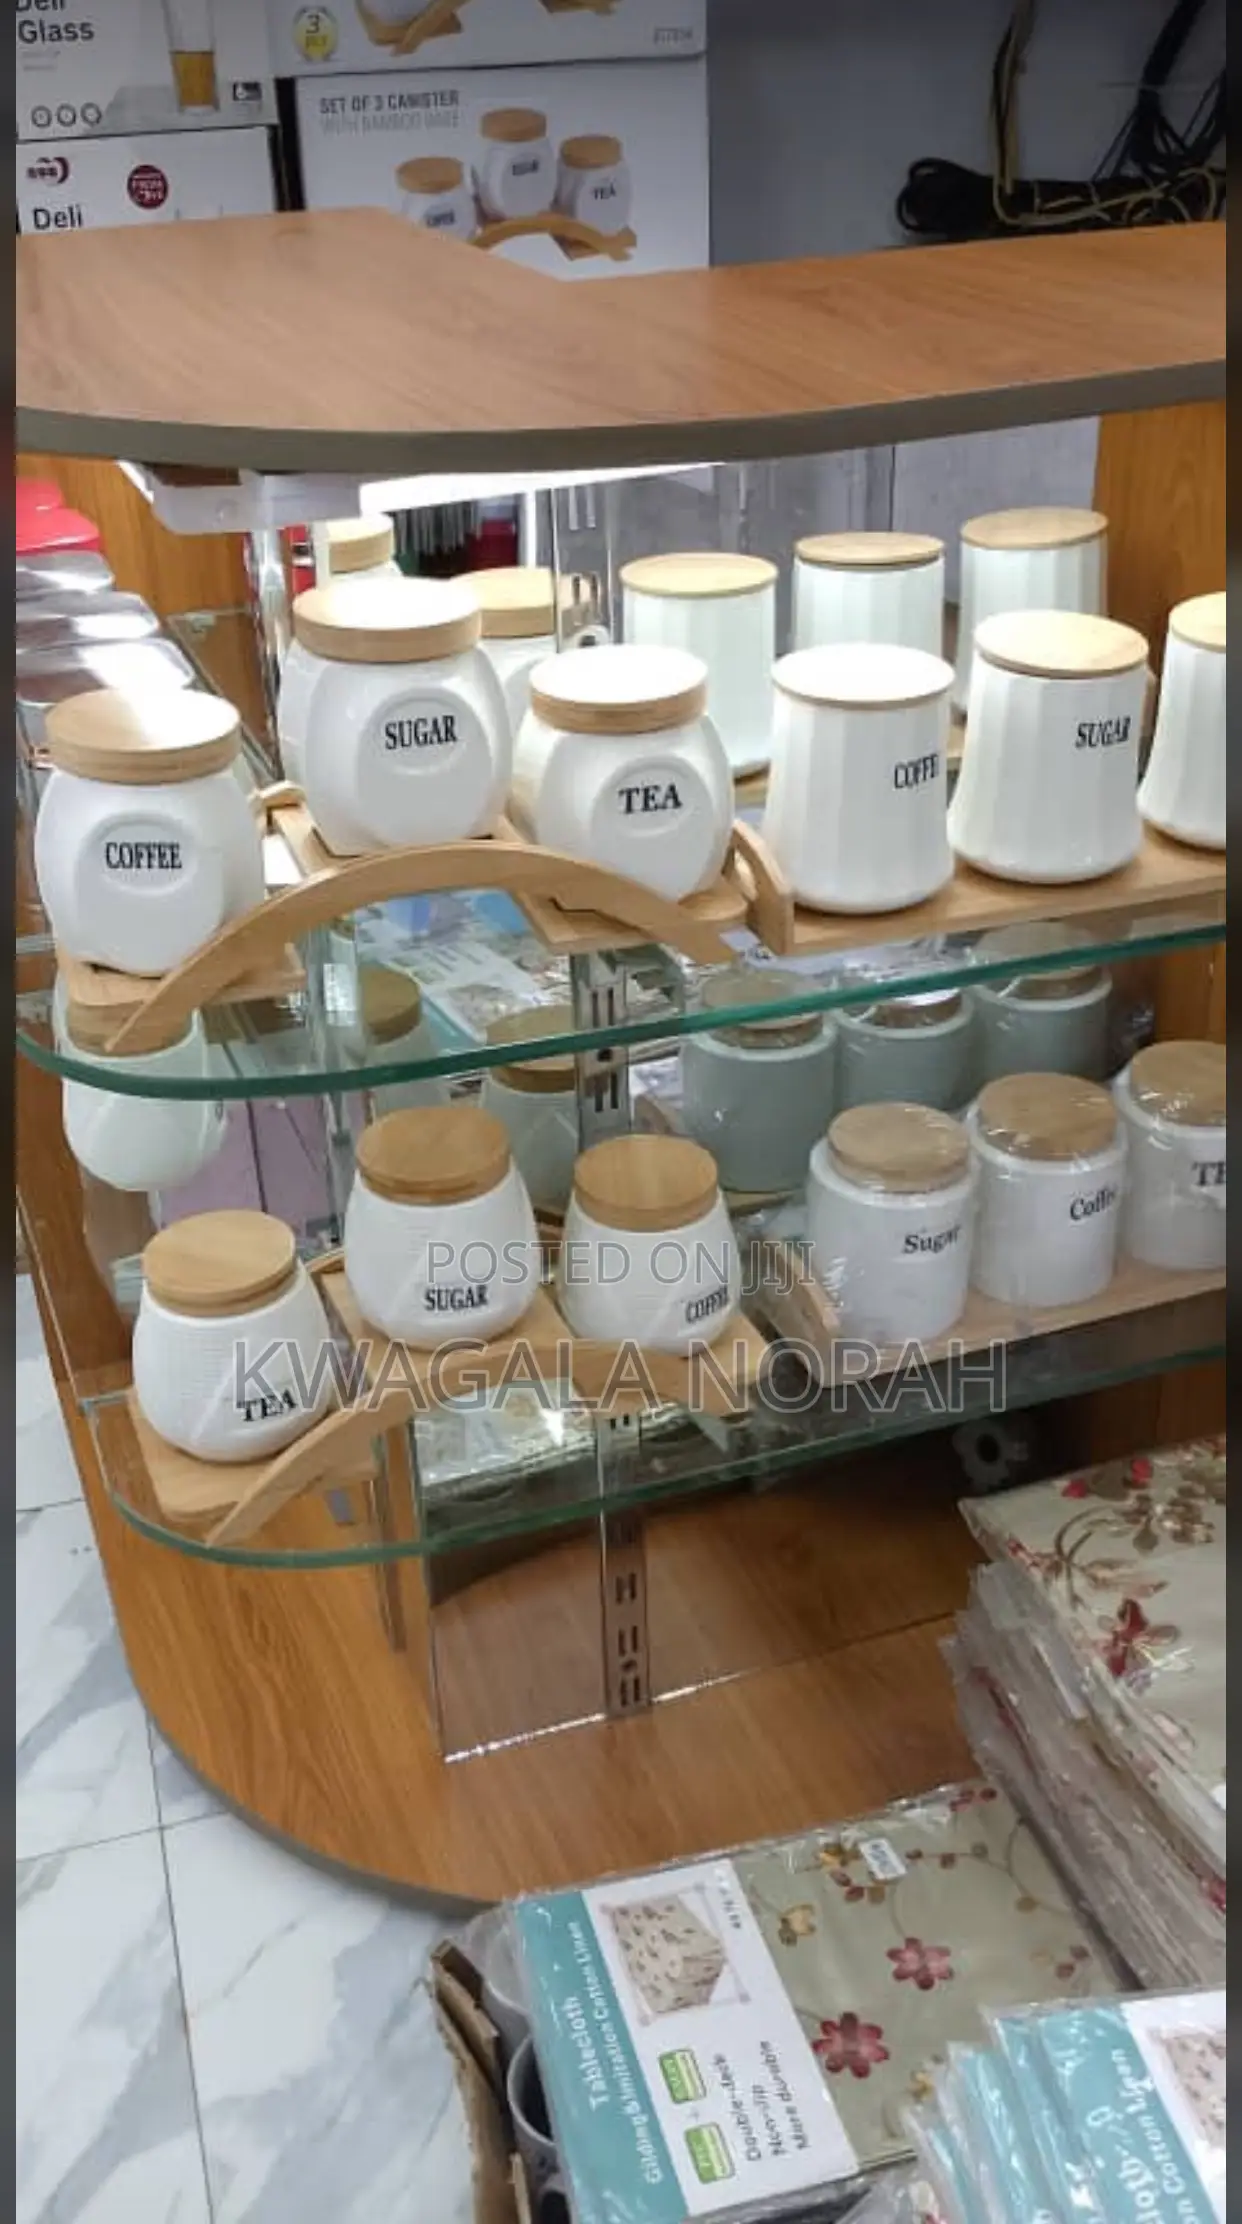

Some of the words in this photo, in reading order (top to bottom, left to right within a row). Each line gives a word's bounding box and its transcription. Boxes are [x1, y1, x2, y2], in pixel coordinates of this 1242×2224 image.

[18, 19, 95, 44] Glass
[319, 97, 346, 114] SET
[351, 95, 370, 112] OF
[593, 182, 617, 200] TEA
[33, 205, 83, 230] Deli
[384, 715, 458, 750] SUGAR
[1075, 715, 1132, 749] SUGAR
[618, 783, 684, 815] TEA
[105, 841, 183, 870] COFFEE
[903, 1223, 962, 1254] Sugar
[423, 1284, 489, 1312] SUGAR
[243, 1388, 297, 1422] TEA
[562, 1996, 609, 2113] Tablecloth
[1137, 2114, 1187, 2195] Cotton
